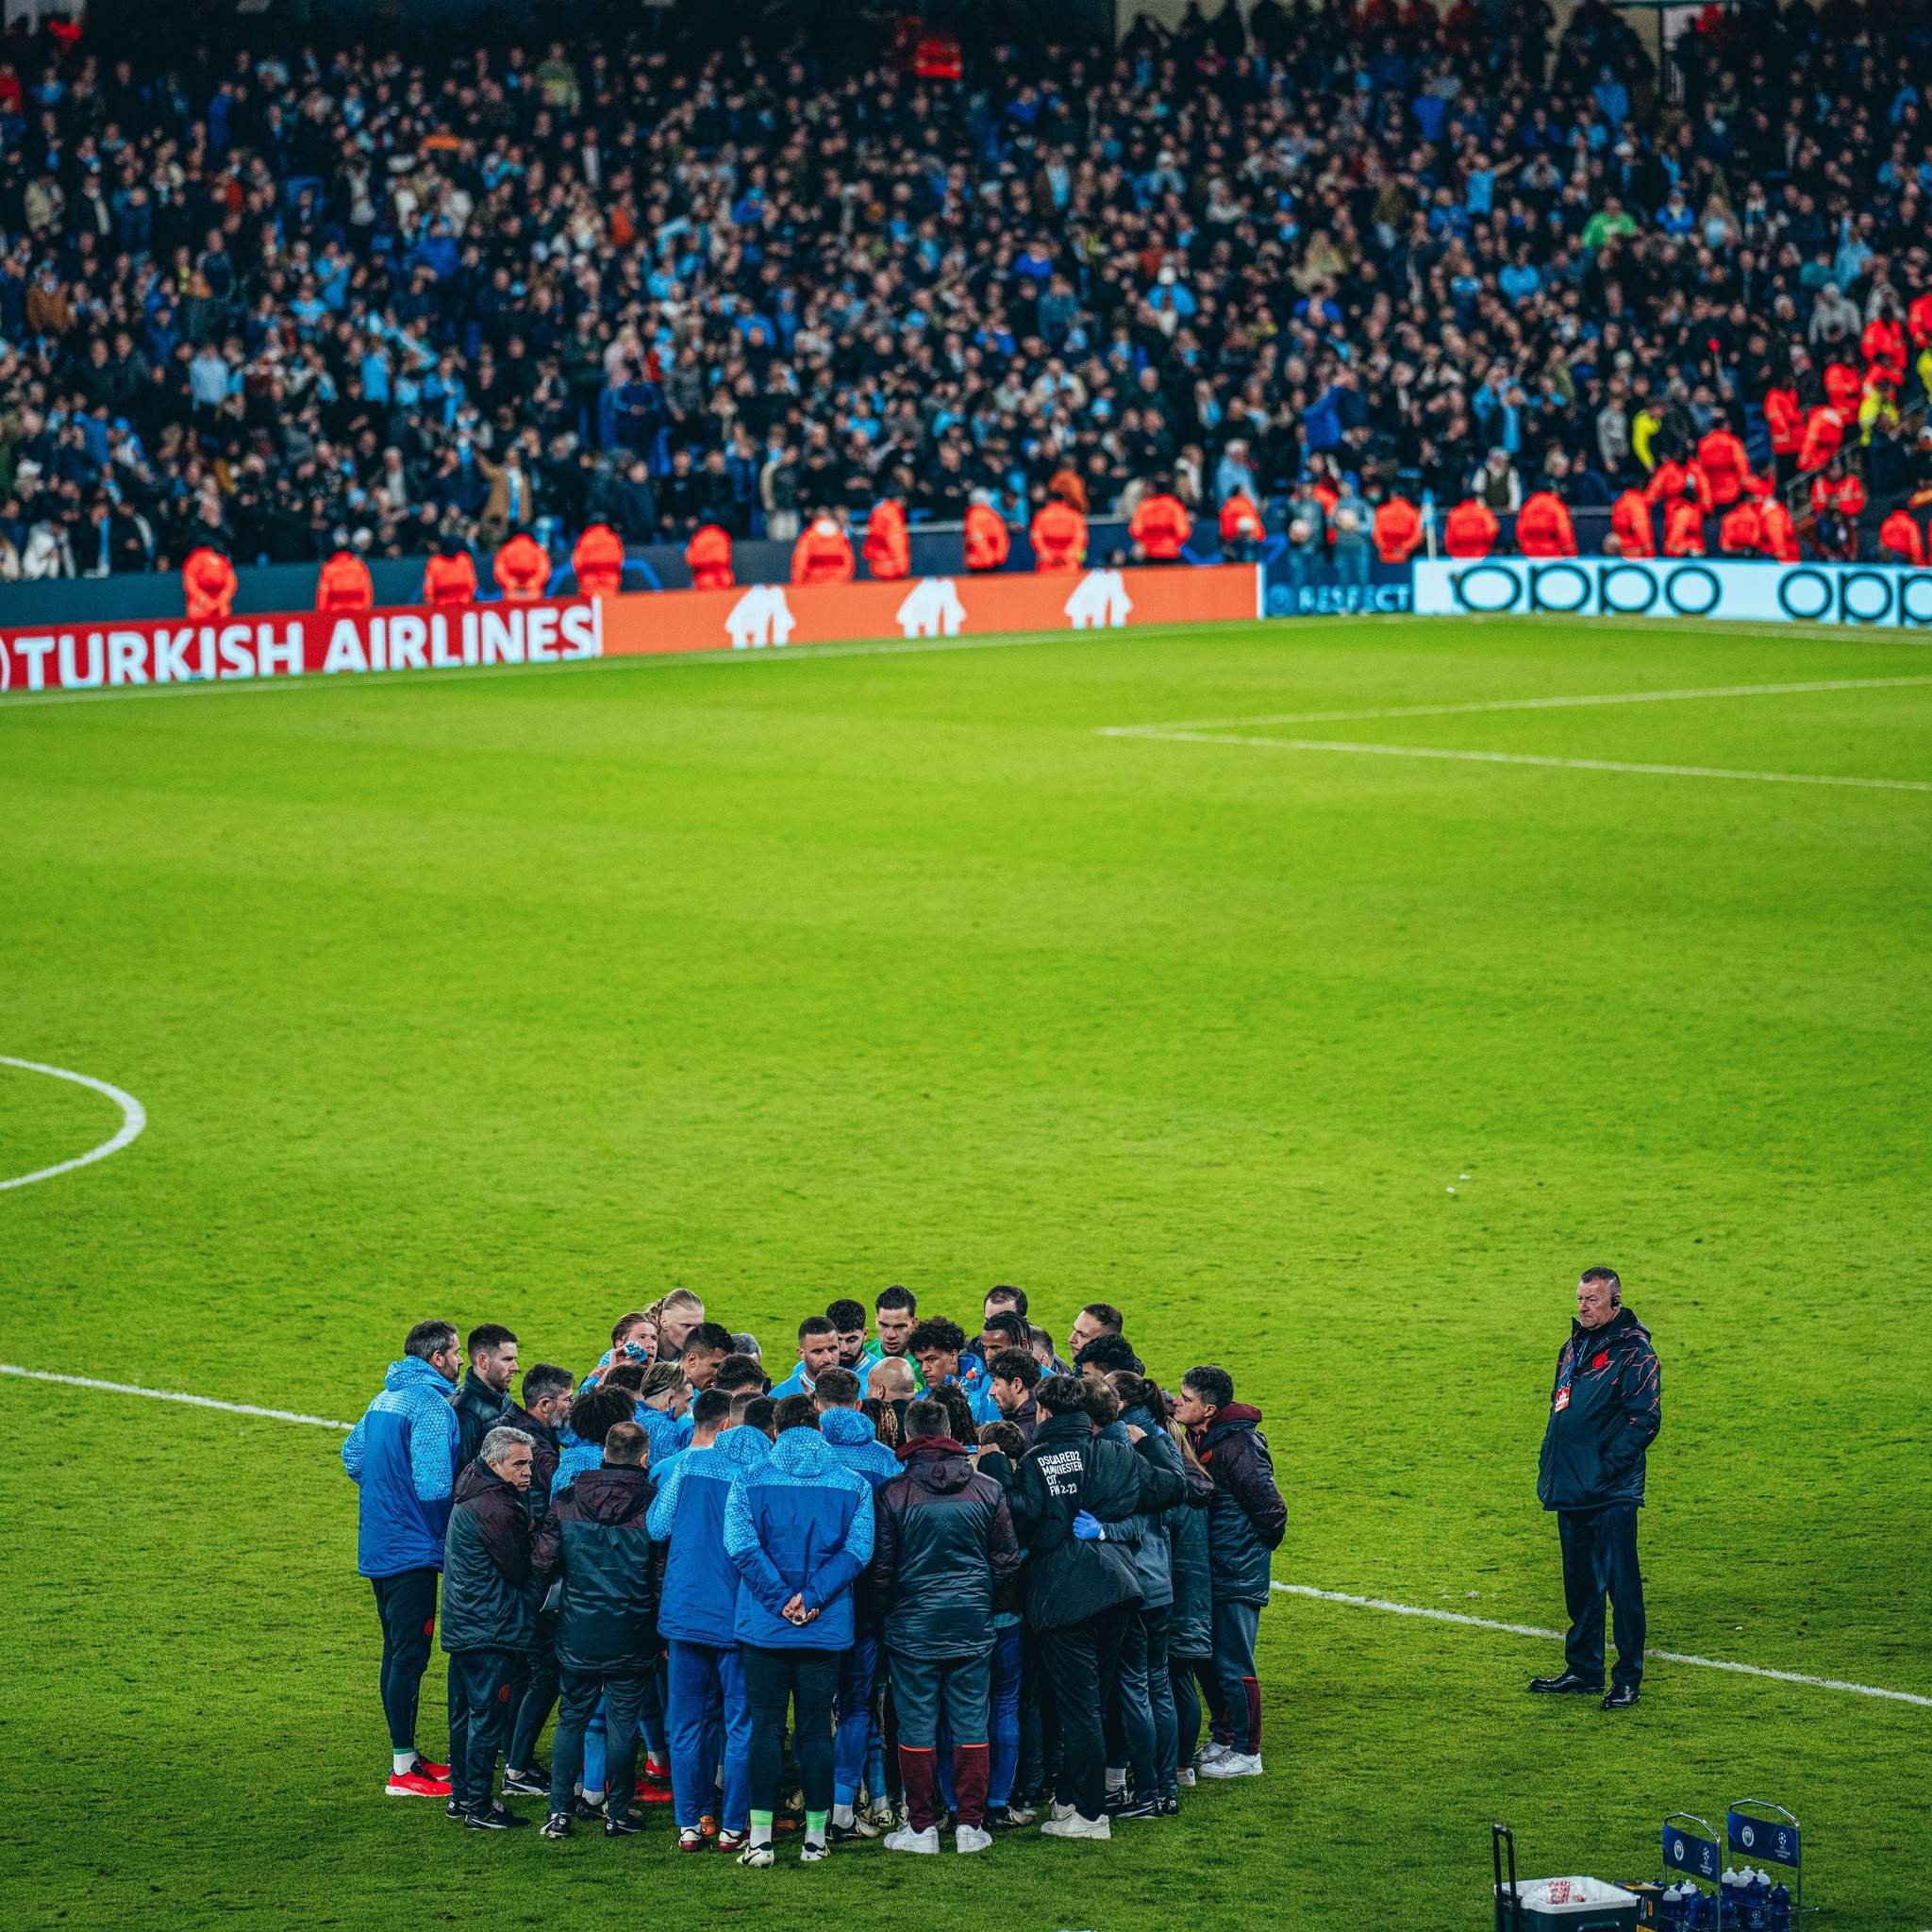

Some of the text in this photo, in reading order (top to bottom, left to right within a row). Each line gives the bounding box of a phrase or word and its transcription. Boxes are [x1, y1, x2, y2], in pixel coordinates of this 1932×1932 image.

[1457, 562, 1722, 616] oppo
[14, 606, 594, 691] TURKISH AIRLINES
[1049, 1484, 1060, 1496] FW
